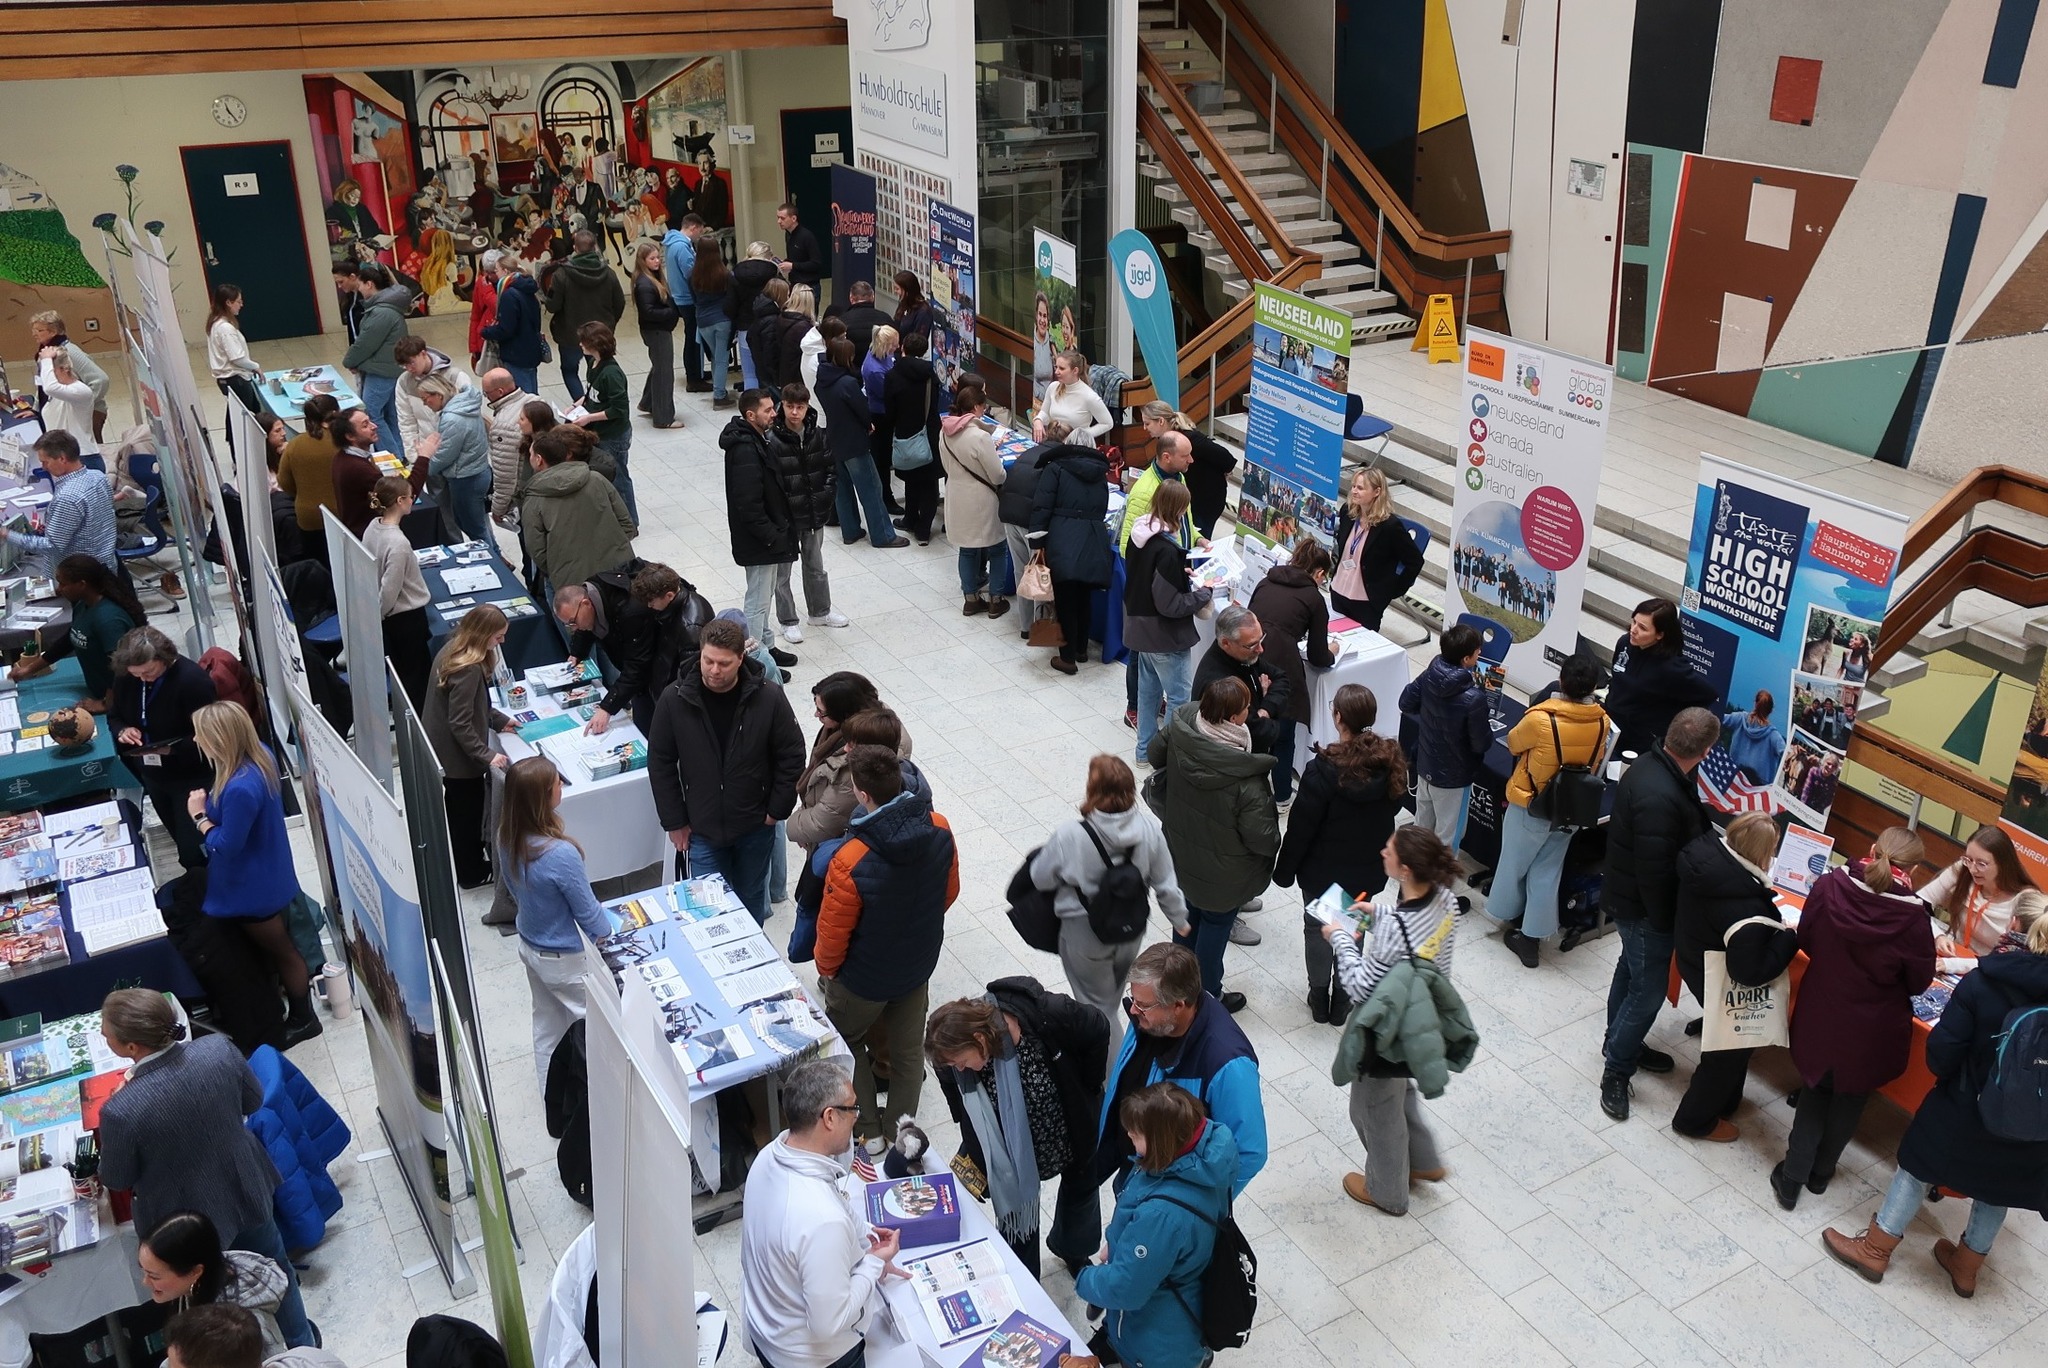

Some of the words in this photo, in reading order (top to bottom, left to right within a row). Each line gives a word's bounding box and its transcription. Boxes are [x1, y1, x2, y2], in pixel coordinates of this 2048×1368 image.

[1130, 263, 1151, 286] ijgd
[1259, 293, 1344, 339] NEUSEELAND
[1471, 356, 1494, 367] HANNOVER
[1271, 390, 1286, 402] Nelson
[1467, 379, 1480, 388] HIGH
[1480, 384, 1504, 396] SCHOOLS
[1569, 376, 1606, 397] global
[1507, 392, 1554, 412] KURZPROGRAMME
[1490, 402, 1565, 440] neuseeland
[1558, 409, 1600, 427] SUMMERCAMPS
[1488, 426, 1533, 455] kanada
[1486, 452, 1544, 484] australien
[1484, 474, 1515, 500] irland
[1536, 494, 1558, 507] WARUM
[1558, 502, 1572, 513] WIR?
[1732, 512, 1796, 546] TASTE
[1734, 529, 1752, 542] the
[1756, 538, 1794, 557] world!
[1819, 542, 1867, 569] Hannover
[1822, 532, 1870, 560] Hauptbüro
[1872, 554, 1885, 566] in
[1709, 534, 1792, 588] HIGH
[1706, 564, 1786, 610] SCHOOL
[1702, 595, 1775, 632] WWW.TASTENET.DE
[1705, 580, 1779, 621] WORLDWIDE
[1682, 650, 1712, 667] stralien
[1683, 640, 1715, 658] useeland
[1471, 782, 1494, 806] TAS
[1725, 991, 1735, 1008] A
[1738, 984, 1770, 1006] PART
